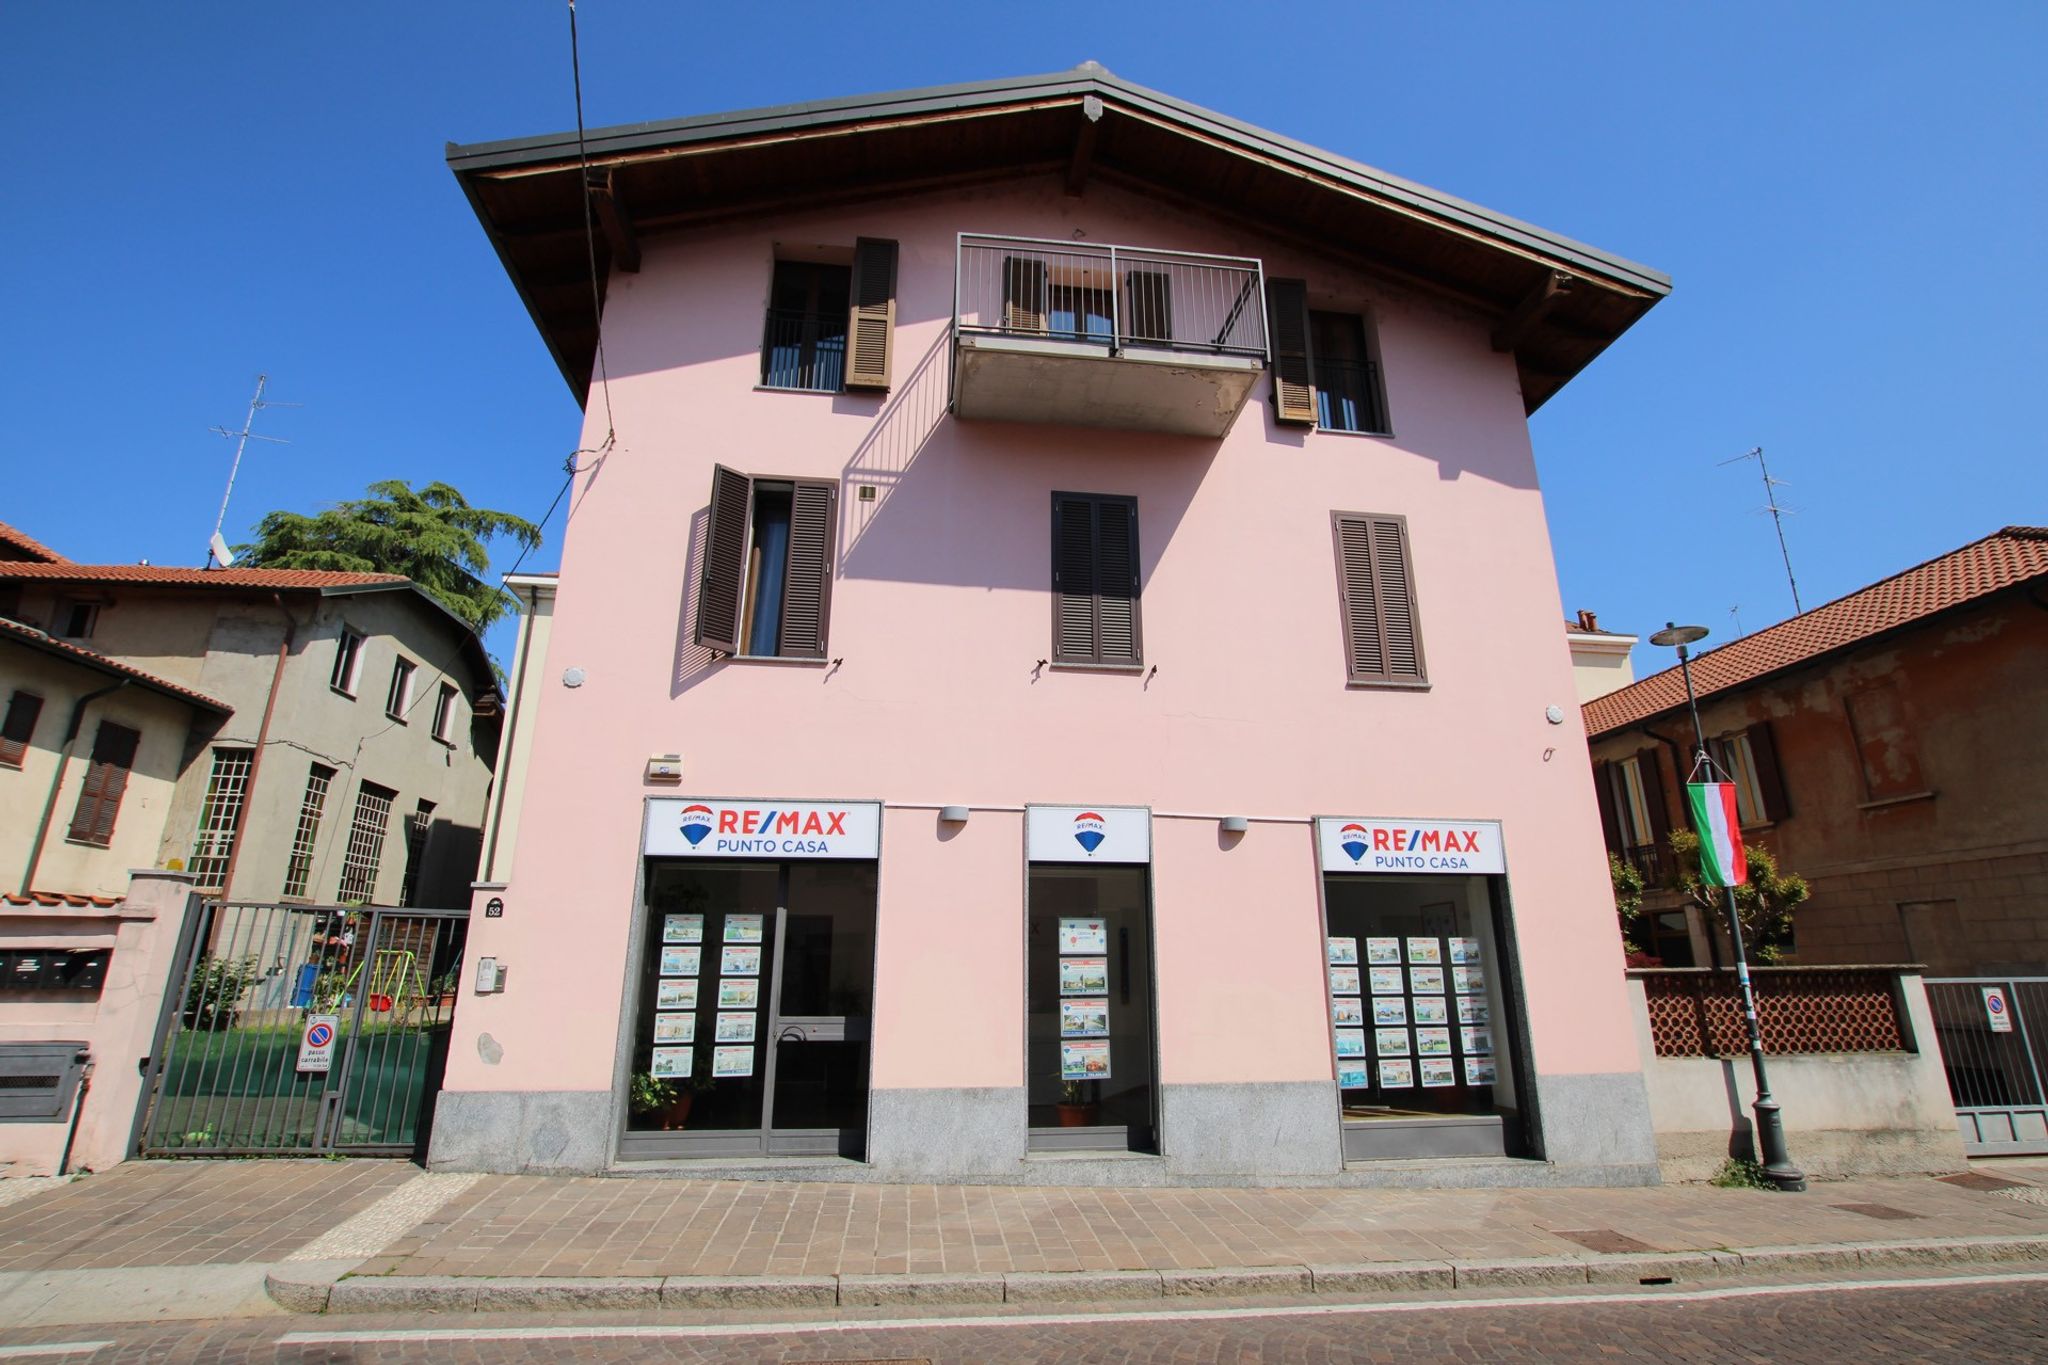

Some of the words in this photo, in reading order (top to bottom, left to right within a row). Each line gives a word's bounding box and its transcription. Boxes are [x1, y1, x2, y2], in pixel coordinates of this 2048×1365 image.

[718, 810, 847, 835] RE/MAX
[717, 839, 776, 852] PUNTO
[782, 840, 828, 853] CASA
[1373, 829, 1480, 852] RE/MAX
[1375, 856, 1425, 868] PUNTO
[1430, 857, 1469, 869] CASA
[488, 907, 500, 916] 52
